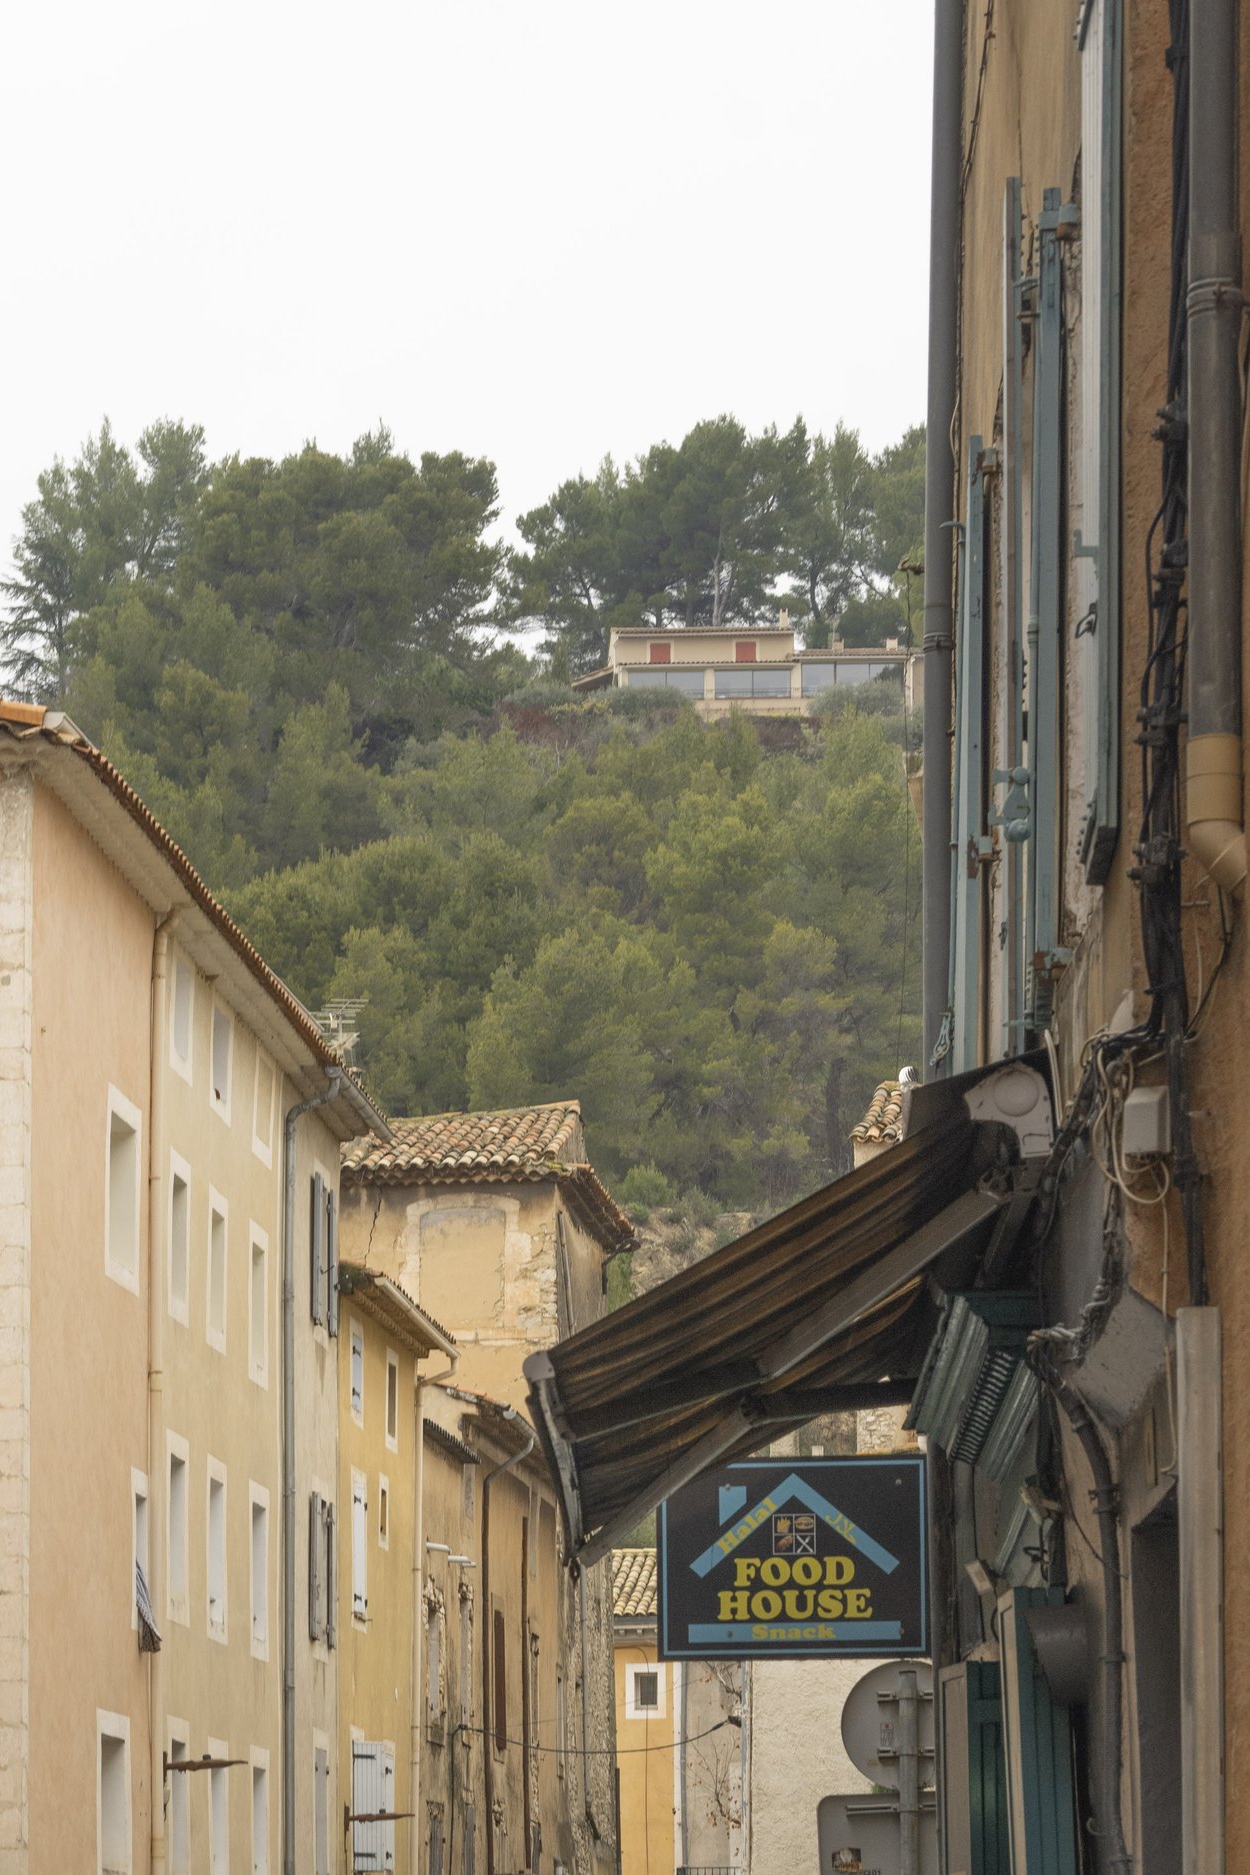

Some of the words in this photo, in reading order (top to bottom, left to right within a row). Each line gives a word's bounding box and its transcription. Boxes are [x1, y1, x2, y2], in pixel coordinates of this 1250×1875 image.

[716, 1497, 778, 1554] Halal
[734, 1556, 855, 1587] FOOD
[718, 1588, 872, 1620] HOUSE
[752, 1623, 836, 1640] Snack
